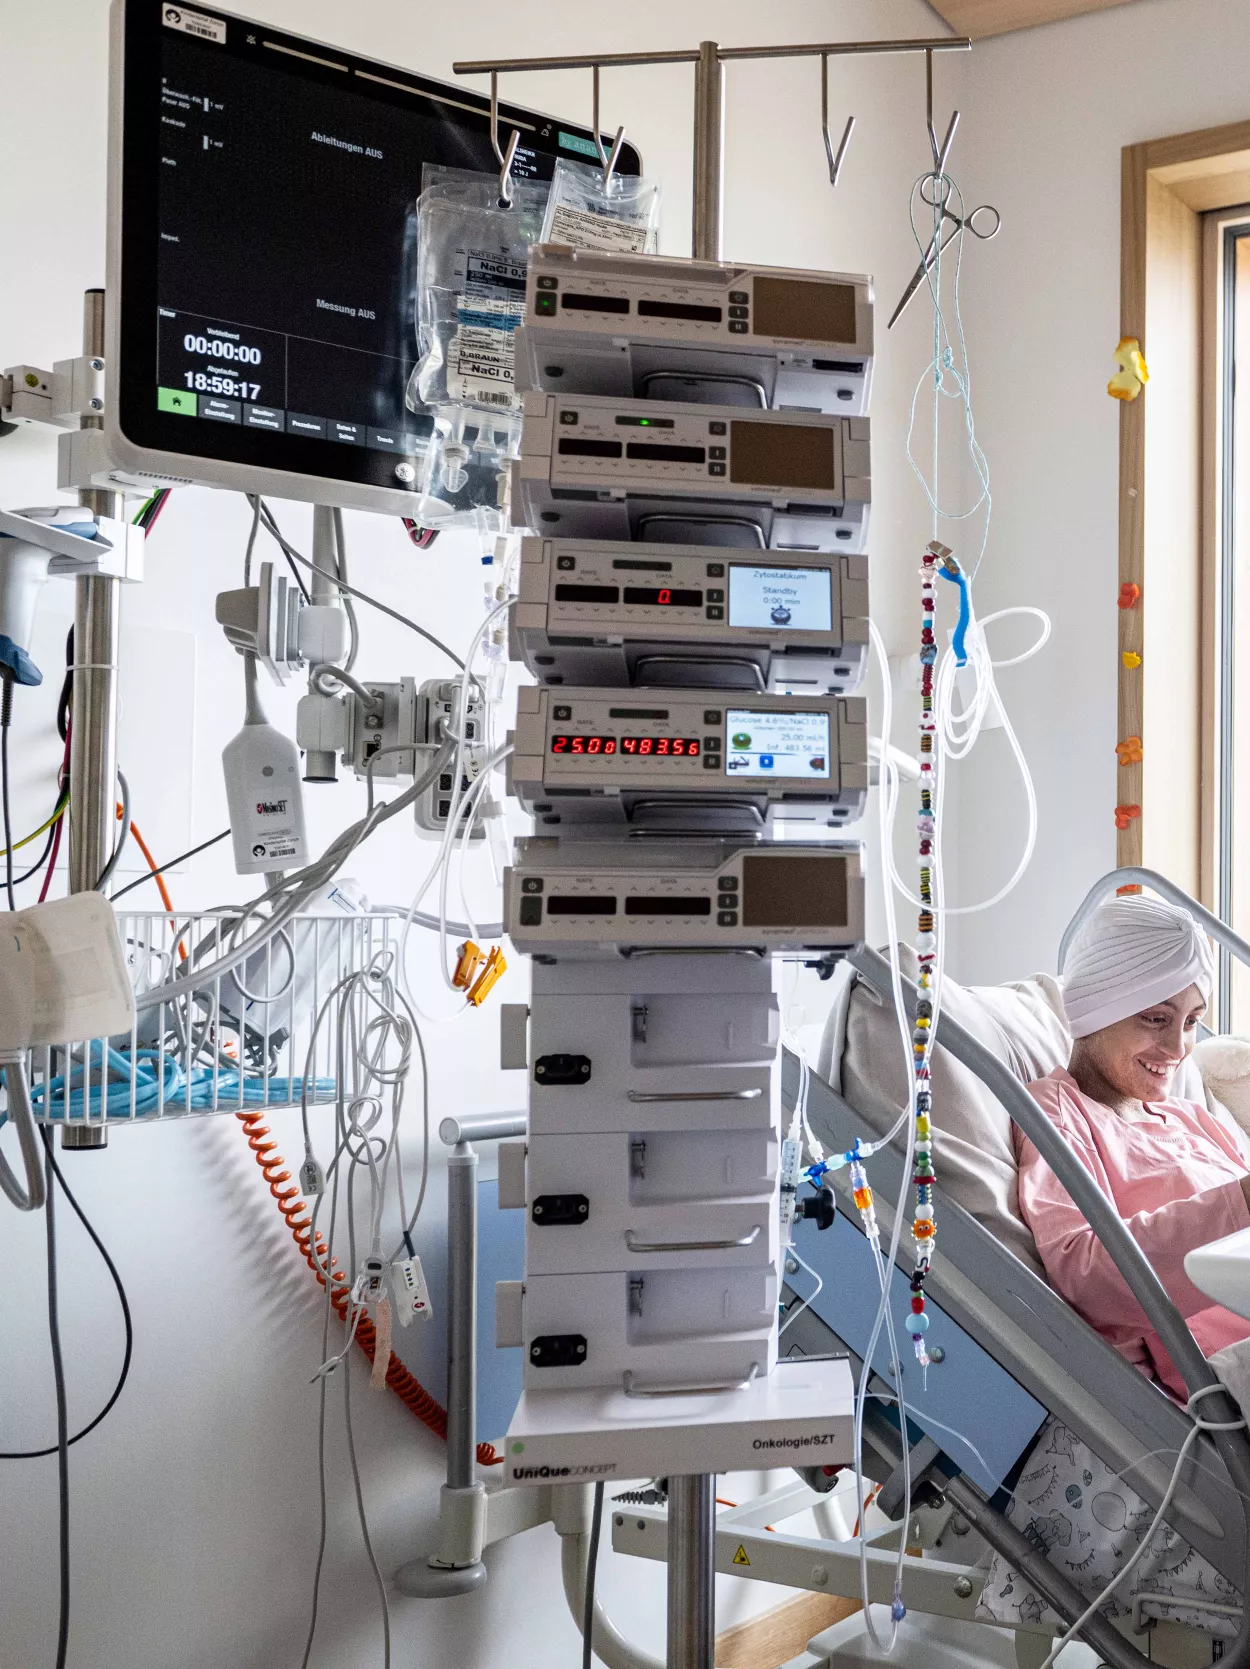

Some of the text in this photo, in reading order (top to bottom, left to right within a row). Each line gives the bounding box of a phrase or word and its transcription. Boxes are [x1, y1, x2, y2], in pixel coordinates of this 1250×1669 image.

[311, 131, 383, 159] Ableitungen AUS
[480, 261, 508, 274] NaCl
[159, 308, 176, 317] Timer
[316, 298, 376, 320] Messung AUS
[184, 334, 262, 365] 00:00:00
[471, 364, 500, 377] NaCl
[184, 371, 261, 400] 18:59:17
[753, 570, 807, 580] Zytostatikum
[762, 586, 797, 596] Standby
[729, 716, 762, 724] Glucose
[752, 1433, 836, 1450] Onkologie/SZT
